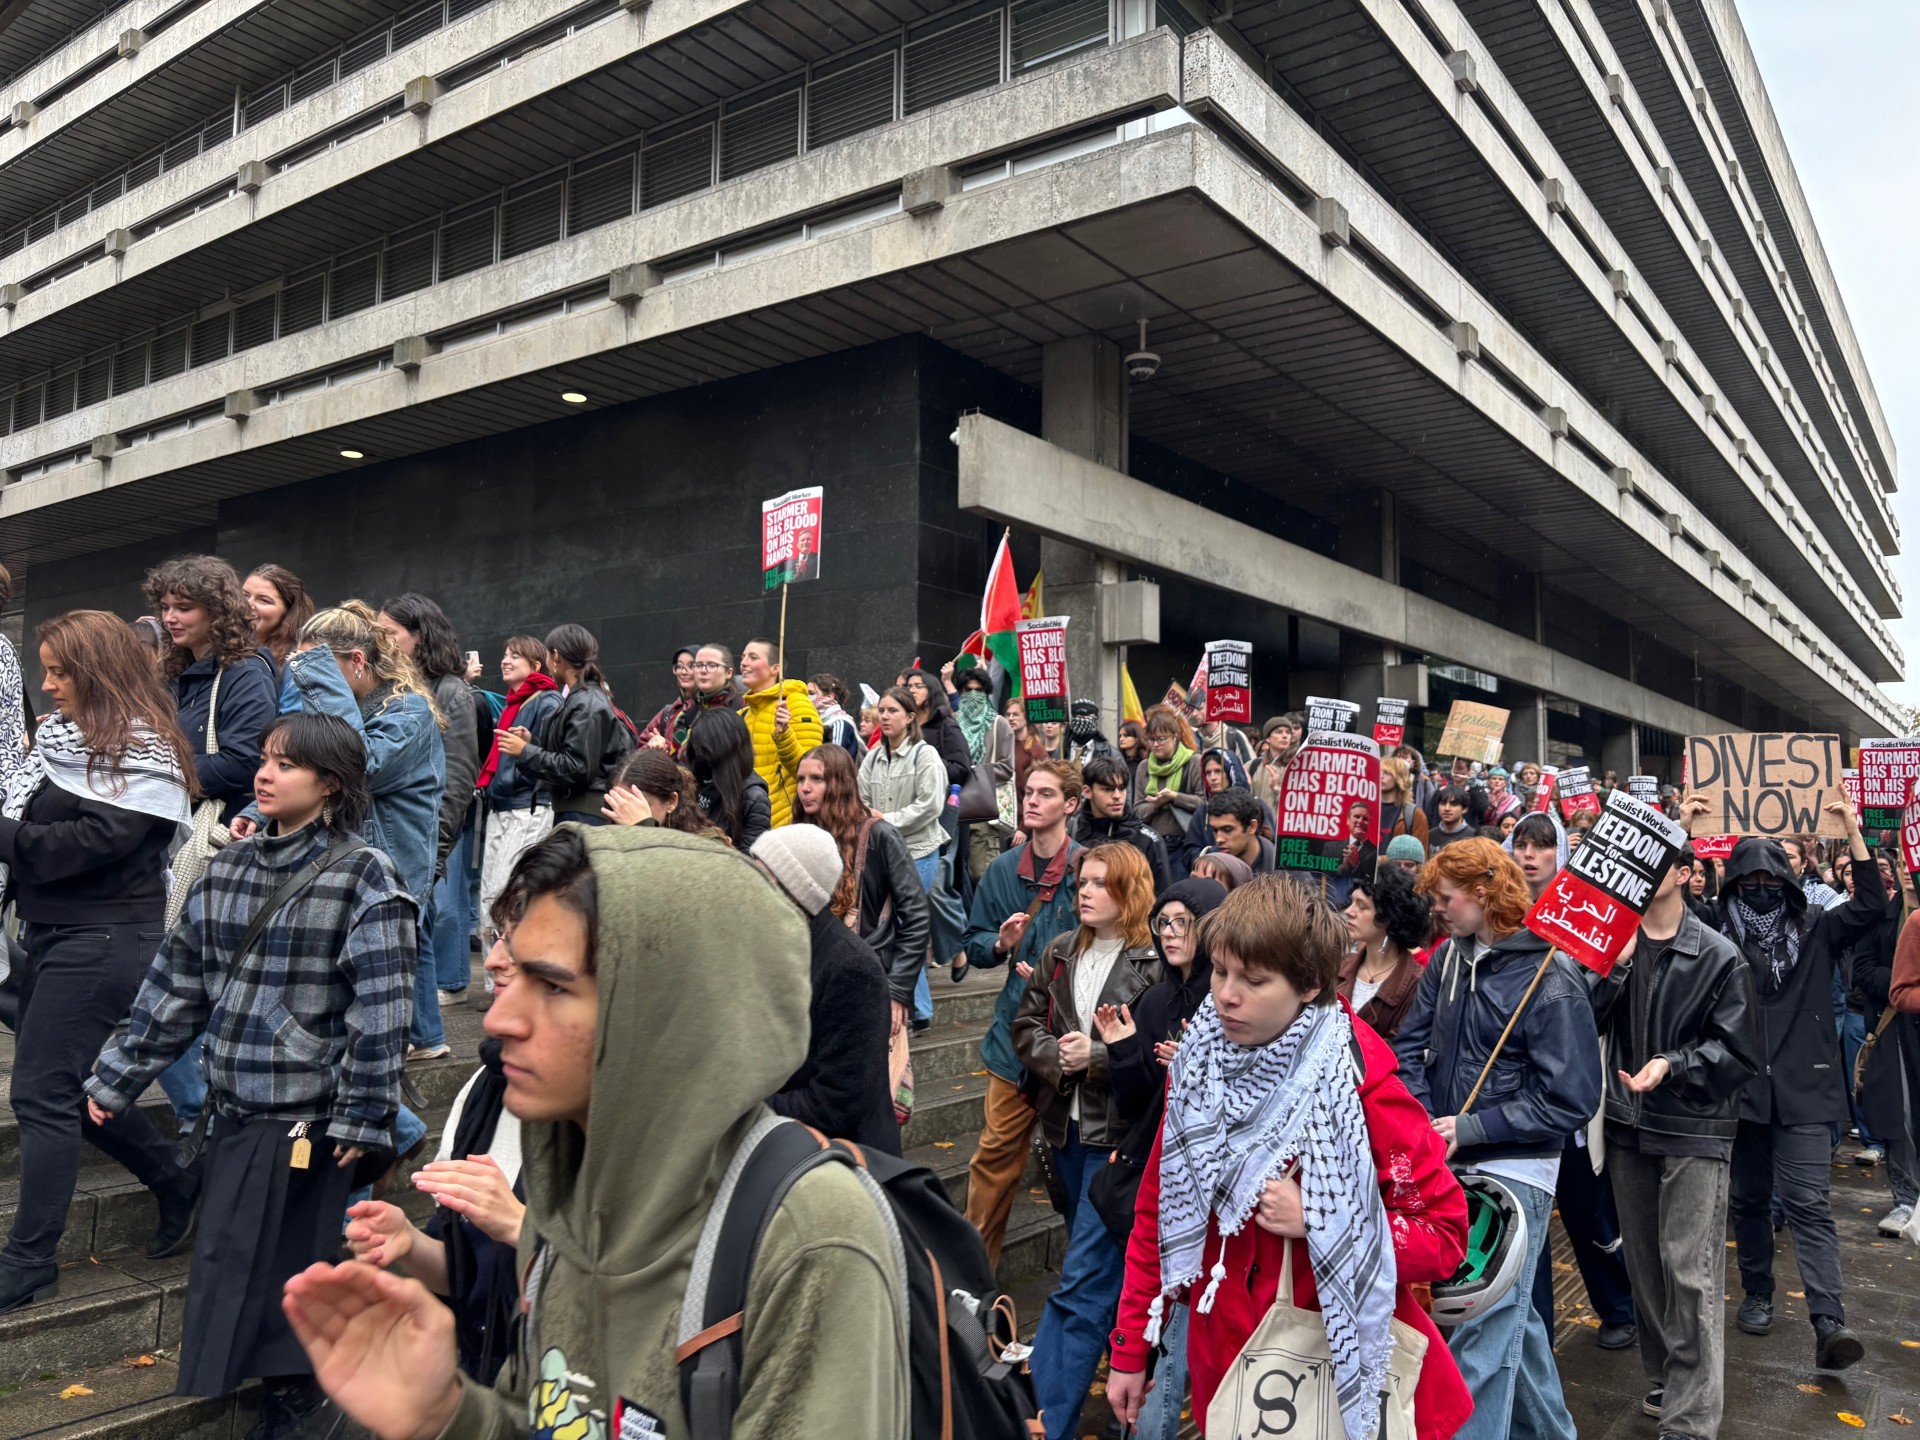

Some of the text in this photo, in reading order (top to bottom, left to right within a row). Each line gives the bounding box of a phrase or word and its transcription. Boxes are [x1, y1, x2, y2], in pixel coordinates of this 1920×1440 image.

[767, 501, 807, 526] STARMER
[767, 513, 817, 539] HAS BLOOD
[767, 530, 794, 553] ON HIS
[767, 544, 793, 567] HANDS
[1023, 648, 1046, 665] HAS
[1212, 652, 1246, 668] FREEDOM
[1025, 663, 1060, 680] ON HIS
[1209, 671, 1248, 687] PALESTINE
[1026, 678, 1060, 696] HANDS
[1214, 690, 1240, 703] الحرية
[1028, 700, 1047, 710] FREE
[1210, 701, 1244, 716] لفلسطين
[1310, 706, 1352, 722] FROM THE
[1308, 717, 1333, 730] RIVER
[1334, 720, 1346, 732] TO
[1342, 739, 1372, 753] Worker
[1290, 750, 1367, 777] STARMER
[1689, 734, 1839, 790] DIVEST
[1862, 751, 1920, 765] STARMER
[1863, 765, 1887, 778] HAS
[1286, 771, 1377, 802] HAS BLOOD
[1558, 773, 1588, 787] FREEDOM
[1630, 782, 1657, 792] FREEDOM
[1864, 778, 1881, 792] ON
[1884, 778, 1906, 791] HIS
[1560, 783, 1593, 799] PALESTINE
[1864, 792, 1906, 806] HANDS
[1285, 791, 1343, 815] ON HIS
[1723, 788, 1823, 834] NOW
[1864, 808, 1885, 819] FREE
[1283, 812, 1340, 837] HANDS
[1642, 811, 1671, 837] Worker
[1281, 838, 1309, 854] FREE
[1604, 844, 1622, 860] for
[1280, 852, 1341, 871] PALESTINE
[1556, 877, 1617, 924] الحرية
[1536, 902, 1612, 953] لفلسطين
[1251, 1369, 1306, 1438] S
